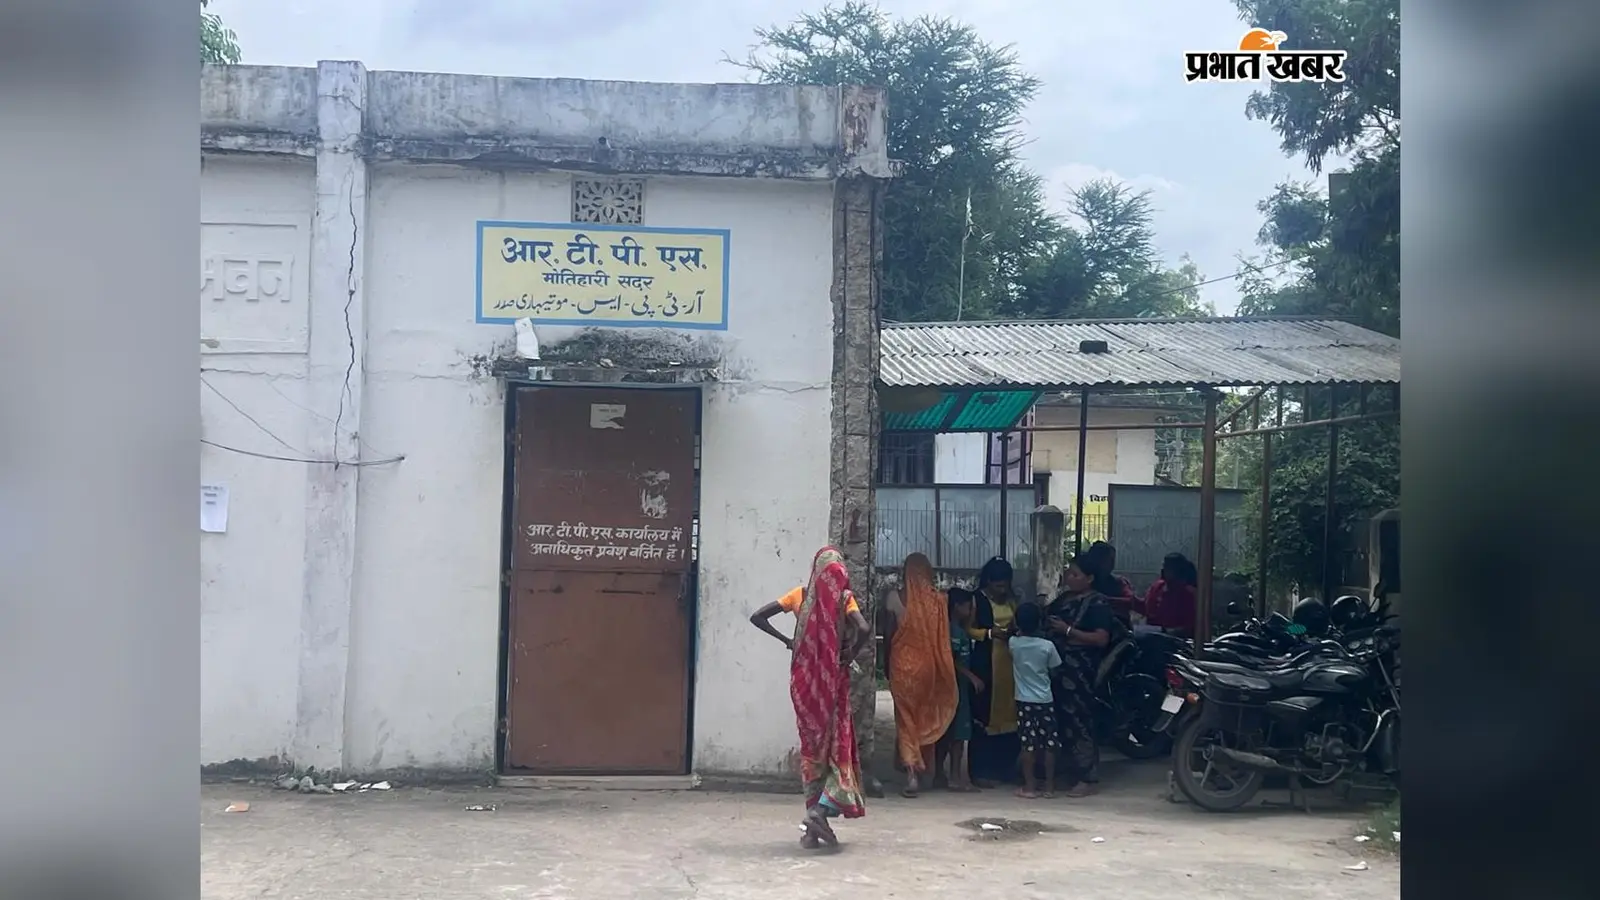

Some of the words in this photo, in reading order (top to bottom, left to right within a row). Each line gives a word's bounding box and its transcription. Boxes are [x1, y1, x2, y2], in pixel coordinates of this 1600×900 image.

[500, 236, 560, 267] आर.
[566, 233, 604, 266] टी.
[610, 236, 647, 267] पी.
[655, 245, 707, 272] एस.
[541, 268, 610, 288] मोतिहारी
[617, 275, 655, 291] सदर
[615, 524, 670, 541] कार्यालय
[671, 526, 683, 541] में
[530, 540, 595, 560] अनाधिकृत
